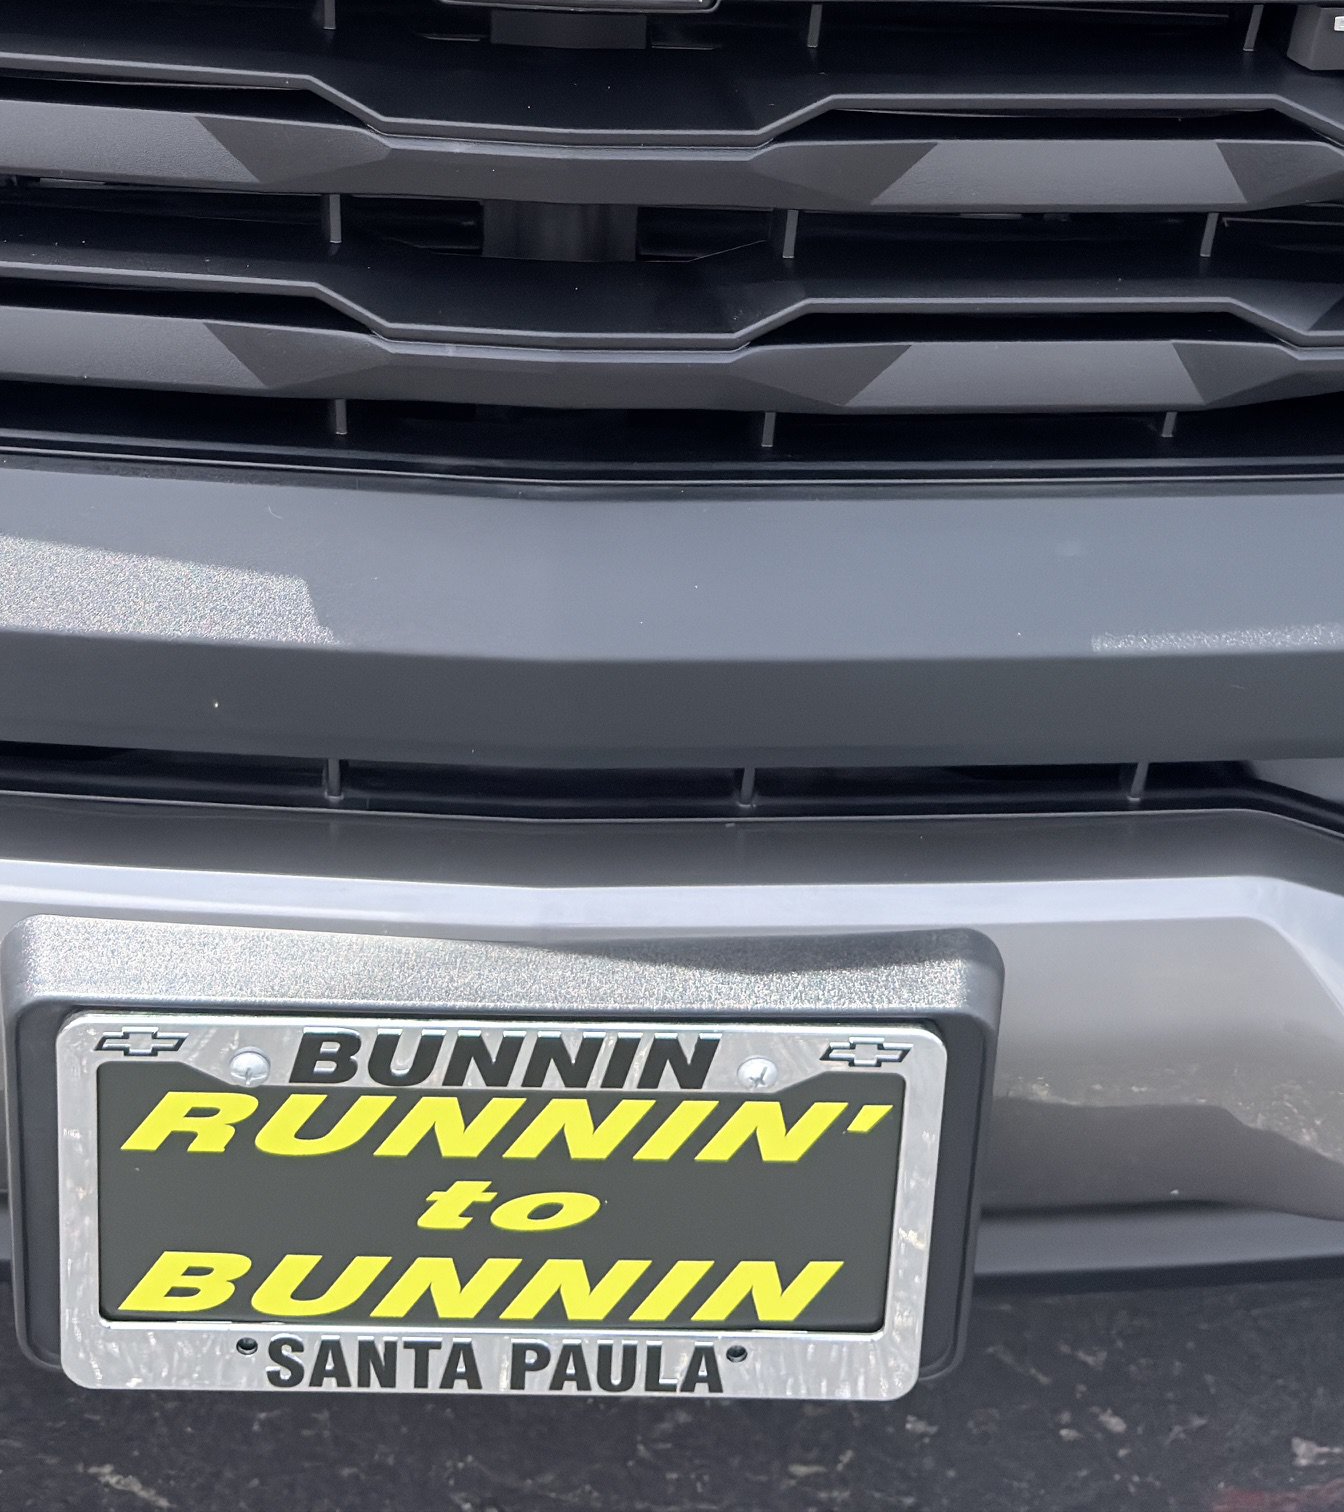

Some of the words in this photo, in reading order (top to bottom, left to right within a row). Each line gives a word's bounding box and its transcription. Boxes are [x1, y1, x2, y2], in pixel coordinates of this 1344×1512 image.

[289, 1027, 720, 1090] BUNNIN
[120, 1091, 894, 1163] RUNNIN'
[416, 1180, 601, 1232] to
[118, 1251, 844, 1322] BUNNIN
[265, 1335, 484, 1390] SANTA
[510, 1338, 724, 1394] PAULA
